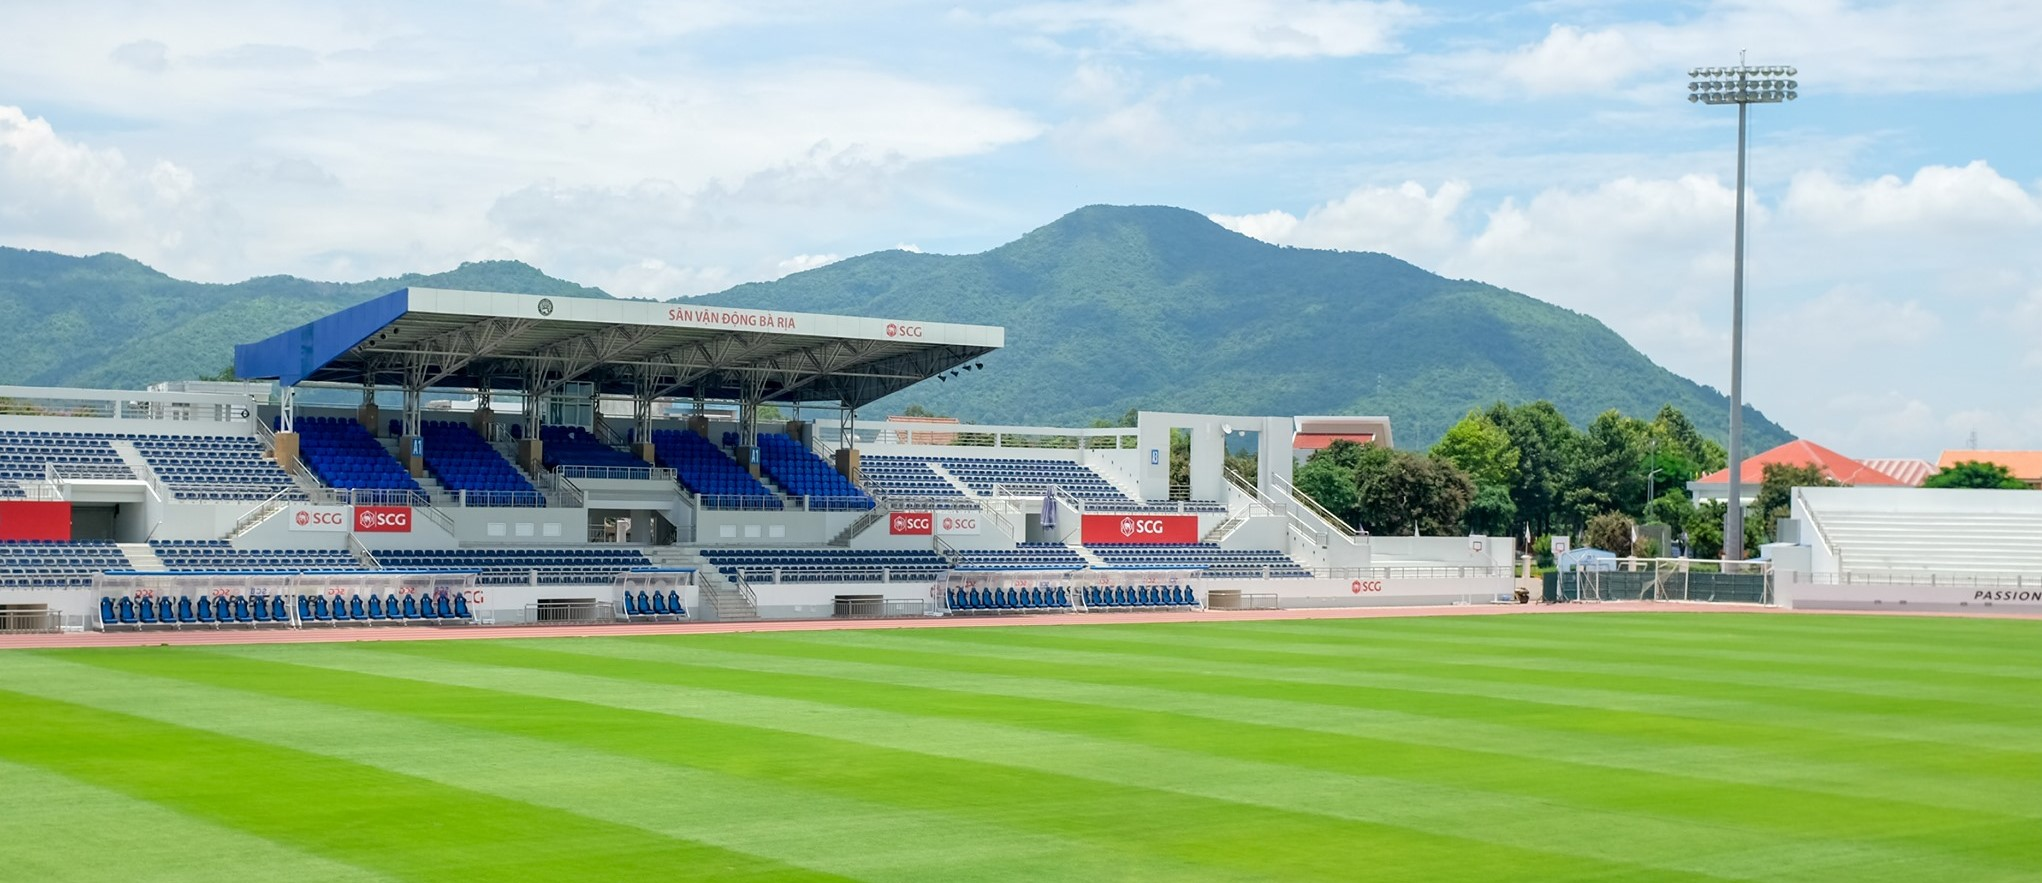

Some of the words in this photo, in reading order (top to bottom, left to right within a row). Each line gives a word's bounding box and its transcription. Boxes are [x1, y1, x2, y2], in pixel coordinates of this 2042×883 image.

[669, 307, 693, 321] SÂN
[695, 309, 719, 325] VẬN
[722, 311, 757, 327] ĐỘNG
[760, 313, 774, 328] BÀ
[777, 316, 796, 331] RỊA
[899, 325, 922, 337] SCG
[412, 439, 421, 454] A1
[751, 449, 759, 463] A1
[313, 512, 342, 524] SCG
[377, 513, 406, 526] SCG
[907, 518, 929, 529] SCG
[955, 519, 976, 529] SCG
[1136, 519, 1163, 534] SCG
[1362, 581, 1382, 592] SCG
[1974, 590, 2042, 601] PASSION
